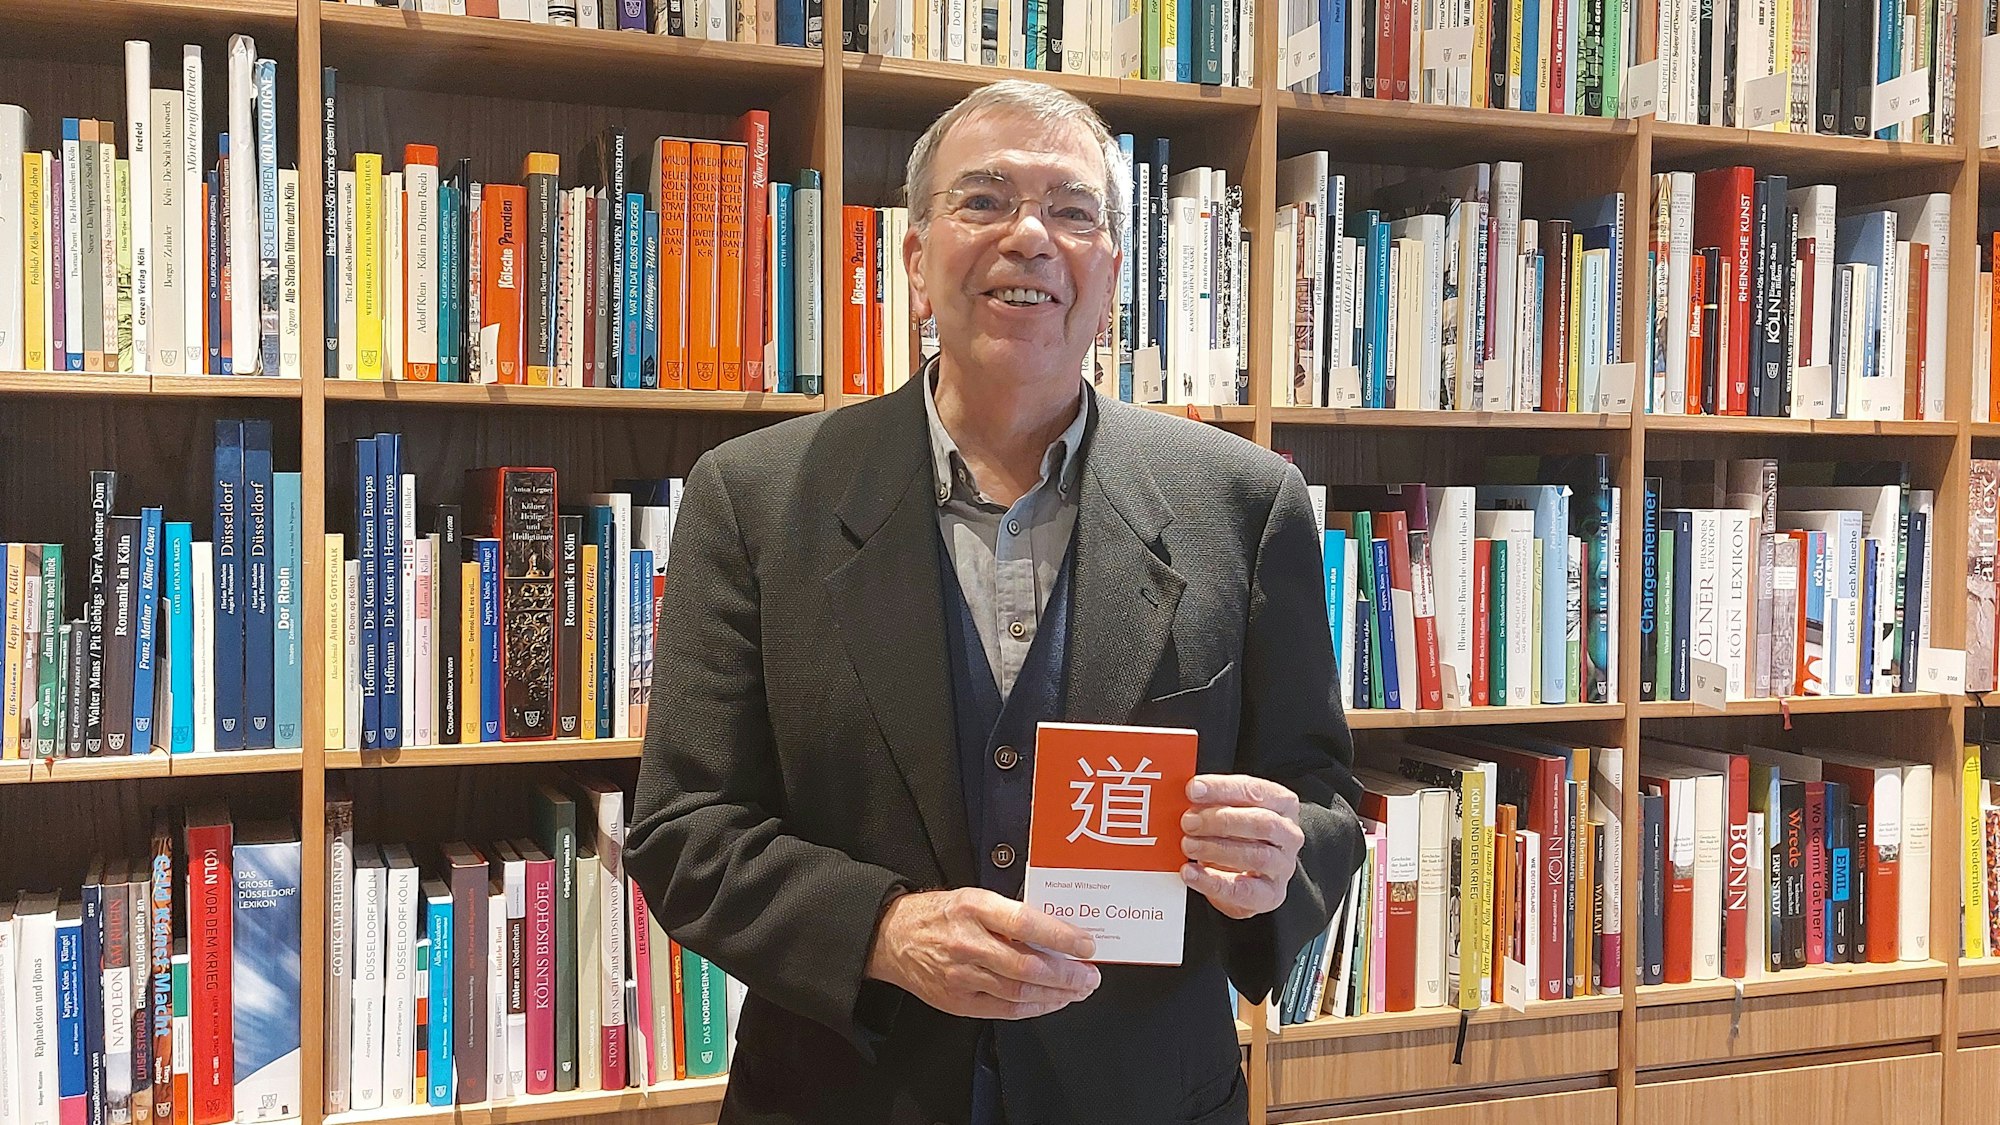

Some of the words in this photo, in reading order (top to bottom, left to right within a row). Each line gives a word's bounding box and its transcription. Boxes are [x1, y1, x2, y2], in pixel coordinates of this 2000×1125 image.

[162, 101, 172, 138] Kunstwerk
[186, 65, 199, 173] Mönchengladbach
[135, 122, 144, 152] Krefeld
[162, 140, 172, 149] als
[754, 122, 768, 160] Karneval
[162, 150, 172, 167] Stadt
[30, 167, 39, 188] Jahre
[163, 168, 172, 182] Die
[417, 173, 427, 198] Reich
[753, 161, 764, 188] Kölner
[29, 190, 40, 215] fuffzich
[163, 189, 172, 206] Köln
[284, 182, 295, 200] Köln
[31, 217, 40, 232] vör
[284, 202, 295, 224] durch
[417, 201, 427, 231] Dritten
[499, 201, 514, 245] Parodien
[1740, 194, 1750, 232] KUNST
[29, 234, 40, 250] Kölle
[164, 225, 173, 257] Zehnder
[285, 226, 296, 252] führen
[417, 233, 427, 245] im
[852, 221, 864, 263] Parodien
[29, 256, 40, 285] Fröhlich
[137, 248, 146, 266] Köln
[285, 254, 296, 287] Straßen
[417, 248, 427, 270] Köln
[498, 248, 515, 288] Kölsche
[1739, 236, 1749, 302] RHEINISCHE
[138, 269, 147, 294] Verlag
[164, 262, 174, 287] Borger
[851, 267, 864, 304] Kölsche
[285, 289, 296, 303] Alle
[417, 282, 427, 305] Klein
[138, 296, 147, 325] Greven
[285, 309, 297, 336] Signon
[417, 307, 427, 333] Adolf
[1690, 305, 1701, 337] Kölsche
[1765, 298, 1781, 343] KÖLN
[92, 483, 105, 508] Dom
[363, 476, 375, 517] Europas
[384, 474, 396, 514] Europas
[220, 481, 234, 557] Düsseldorf
[251, 481, 264, 556] Düsseldorf
[1458, 500, 1468, 520] Jahr
[92, 511, 104, 561] Aachener
[145, 527, 156, 555] Oasen
[363, 522, 374, 558] Herzen
[384, 518, 395, 554] Herzen
[1458, 522, 1467, 537] das
[1700, 519, 1708, 570] PERSONEN
[1707, 519, 1715, 570] LEXIKON
[1976, 477, 1997, 582] artifex
[116, 535, 130, 564] Köln
[564, 533, 576, 560] Köln
[1457, 539, 1467, 565] durch
[1641, 489, 1656, 634] Chargesheimer
[1731, 520, 1743, 600] LEXIKON
[1847, 530, 1858, 575] Minsche
[91, 564, 103, 583] Der
[116, 568, 129, 579] in
[143, 558, 155, 590] Kölner
[330, 548, 338, 600] GOTTSCHALK
[364, 561, 374, 575] im
[384, 558, 395, 572] im
[564, 563, 575, 574] in
[1813, 554, 1824, 586] KÖLN
[277, 568, 290, 604] Rhein
[363, 578, 375, 608] Kunst
[384, 576, 395, 605] Kunst
[1457, 567, 1469, 602] Bräuche
[1847, 578, 1857, 598] och
[91, 594, 104, 633] Siebigs
[115, 582, 129, 636] Romanik
[564, 577, 576, 626] Romanik
[1848, 600, 1856, 616] sin
[141, 604, 152, 639] Mathar
[277, 607, 290, 629] Der
[330, 603, 338, 640] ANDREAS
[364, 610, 375, 629] Die
[384, 608, 395, 627] Die
[1457, 605, 1467, 651] Rheinische
[1694, 574, 1714, 662] ÖLNER
[1847, 619, 1857, 644] Lück
[90, 635, 101, 650] Pit
[1727, 609, 1742, 659] KÖLN
[140, 642, 151, 670] Franz
[363, 644, 375, 696] Hoffmann
[384, 642, 395, 694] Hoffmann
[90, 661, 101, 688] Maas
[43, 688, 51, 706] Amm
[89, 692, 101, 726] Walter
[42, 709, 53, 726] Gaby
[1066, 756, 1162, 846] 道
[1812, 803, 1822, 824] Wo
[1471, 820, 1479, 841] UND
[1788, 808, 1801, 868] Wrede
[1971, 816, 1980, 837] Am
[204, 849, 220, 884] KÖLN
[1471, 845, 1479, 865] DER
[1547, 836, 1563, 885] KÖLN
[1729, 823, 1748, 911] BONN
[1812, 827, 1823, 877] kommt
[154, 854, 171, 901] Geld
[239, 871, 256, 879] DAS
[239, 880, 273, 889] GROSSE
[333, 837, 345, 912] RHEINLAND
[1045, 881, 1072, 890] Michael
[1074, 882, 1110, 891] Wittschier
[1470, 868, 1478, 899] KRIEG
[1772, 854, 1781, 917] ERFTSTADT
[1836, 855, 1847, 893] EMIL
[1971, 839, 1981, 906] Niederrhein
[205, 888, 218, 914] VOR
[239, 888, 296, 899] DÜSSELDORF
[239, 900, 276, 909] LEXIKON
[365, 874, 377, 905] KÖLN
[396, 874, 409, 905] KÖLN
[1813, 881, 1822, 904] dat
[136, 899, 145, 911] an
[535, 881, 550, 955] BISCHÖFE
[1044, 903, 1074, 917] Dao
[1080, 904, 1100, 918] De
[1105, 905, 1164, 921] Colonia
[109, 899, 122, 942] RHEIN
[135, 913, 146, 933] sich
[205, 919, 218, 947] DEM
[333, 915, 344, 931] IM
[1813, 908, 1823, 939] her?
[135, 935, 146, 962] blickt
[153, 908, 171, 967] Kunst
[363, 906, 377, 980] DÜSSELDORF
[395, 906, 408, 980] DÜSSELDORF
[511, 924, 521, 966] Niederrhein
[110, 944, 123, 965] AM
[333, 934, 344, 976] GOTIK
[136, 964, 146, 986] Frau
[205, 951, 218, 990] KRIEG
[513, 968, 521, 979] am
[535, 958, 550, 1009] KÖLNS
[112, 971, 124, 1047] NAPOLEON
[136, 988, 146, 1009] Eine
[154, 974, 171, 1037] Macht
[512, 981, 521, 1009] Altbier
[136, 1011, 146, 1050] STRAUS
[137, 1053, 147, 1080] LUISE
